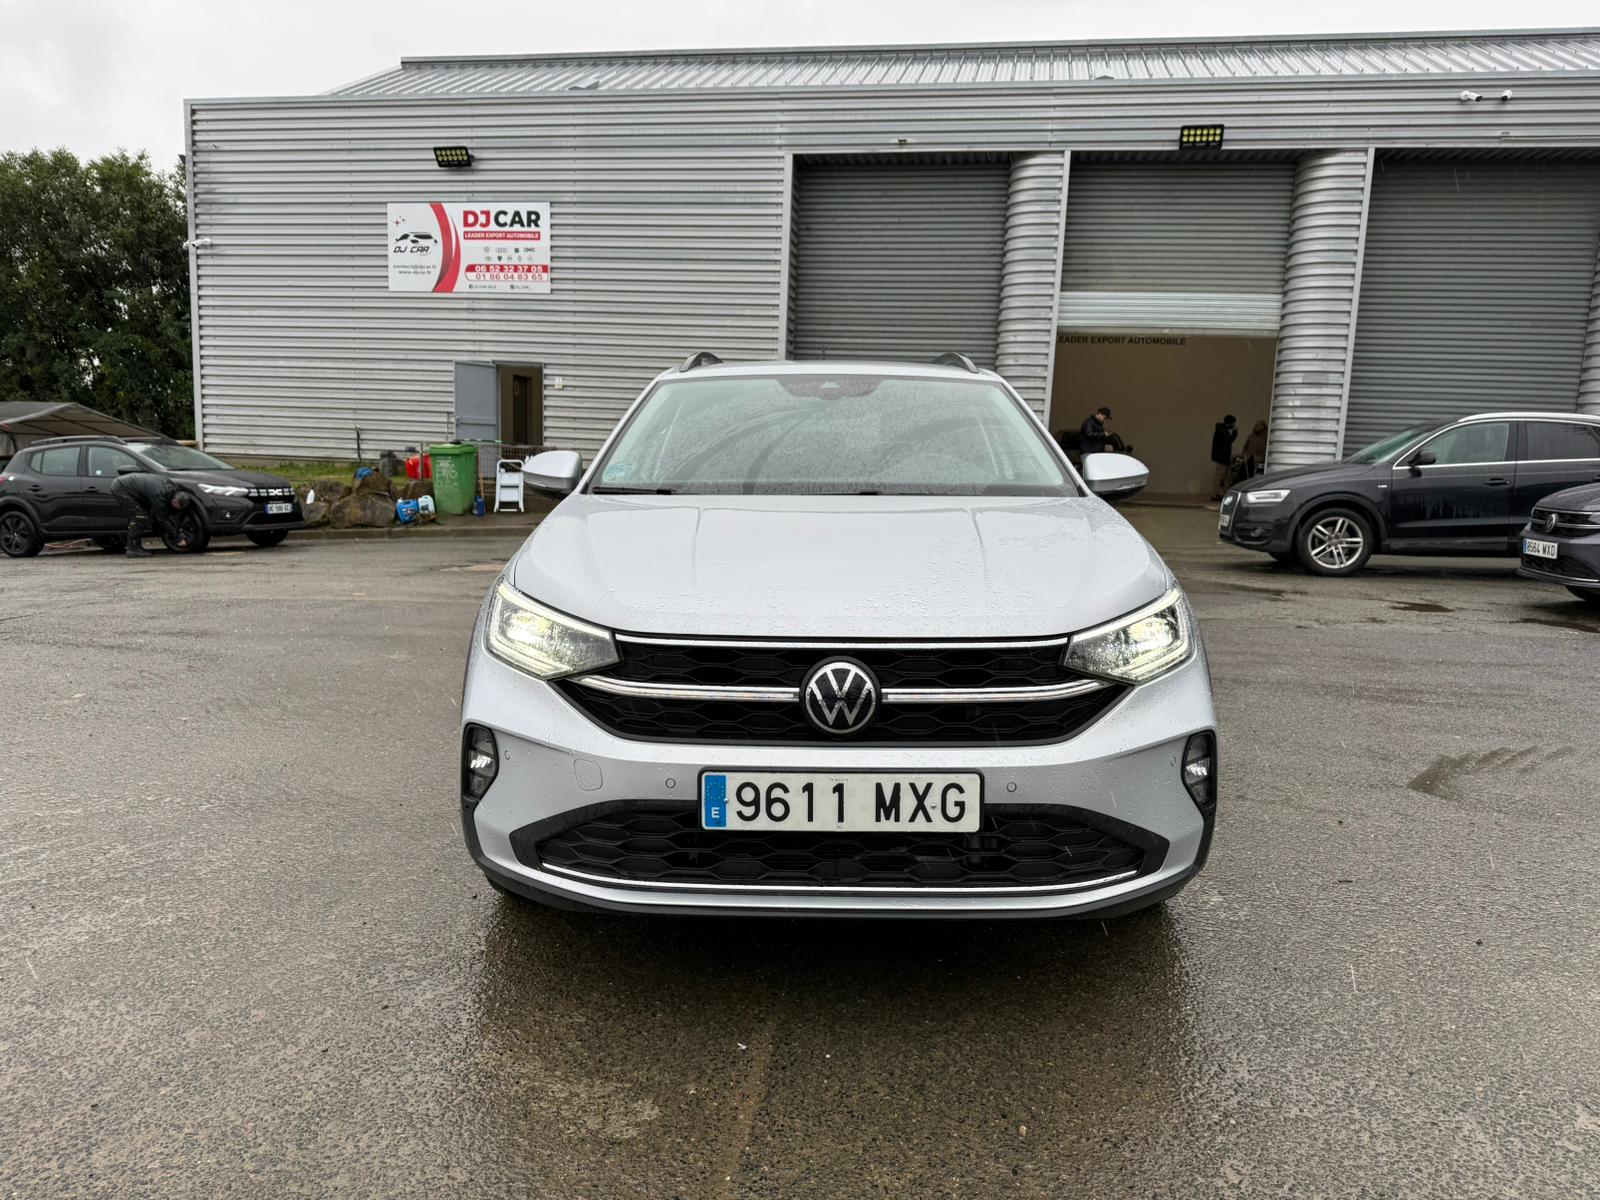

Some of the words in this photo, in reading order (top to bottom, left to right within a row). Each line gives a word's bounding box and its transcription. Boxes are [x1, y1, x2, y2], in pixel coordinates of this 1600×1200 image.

[463, 210, 490, 228] DJ
[494, 210, 541, 228] CAR
[475, 265, 486, 273] 06
[490, 265, 501, 273] 52
[503, 265, 514, 273] 32
[517, 265, 528, 273] 37
[531, 265, 543, 273] 05
[531, 273, 543, 281] 65
[1091, 335, 1125, 344] EXPORT
[1128, 336, 1186, 346] AUTOMOBILE
[1542, 543, 1556, 557] MXD
[735, 781, 846, 823] 9611
[875, 782, 966, 823] MXG
[711, 807, 720, 819] E
